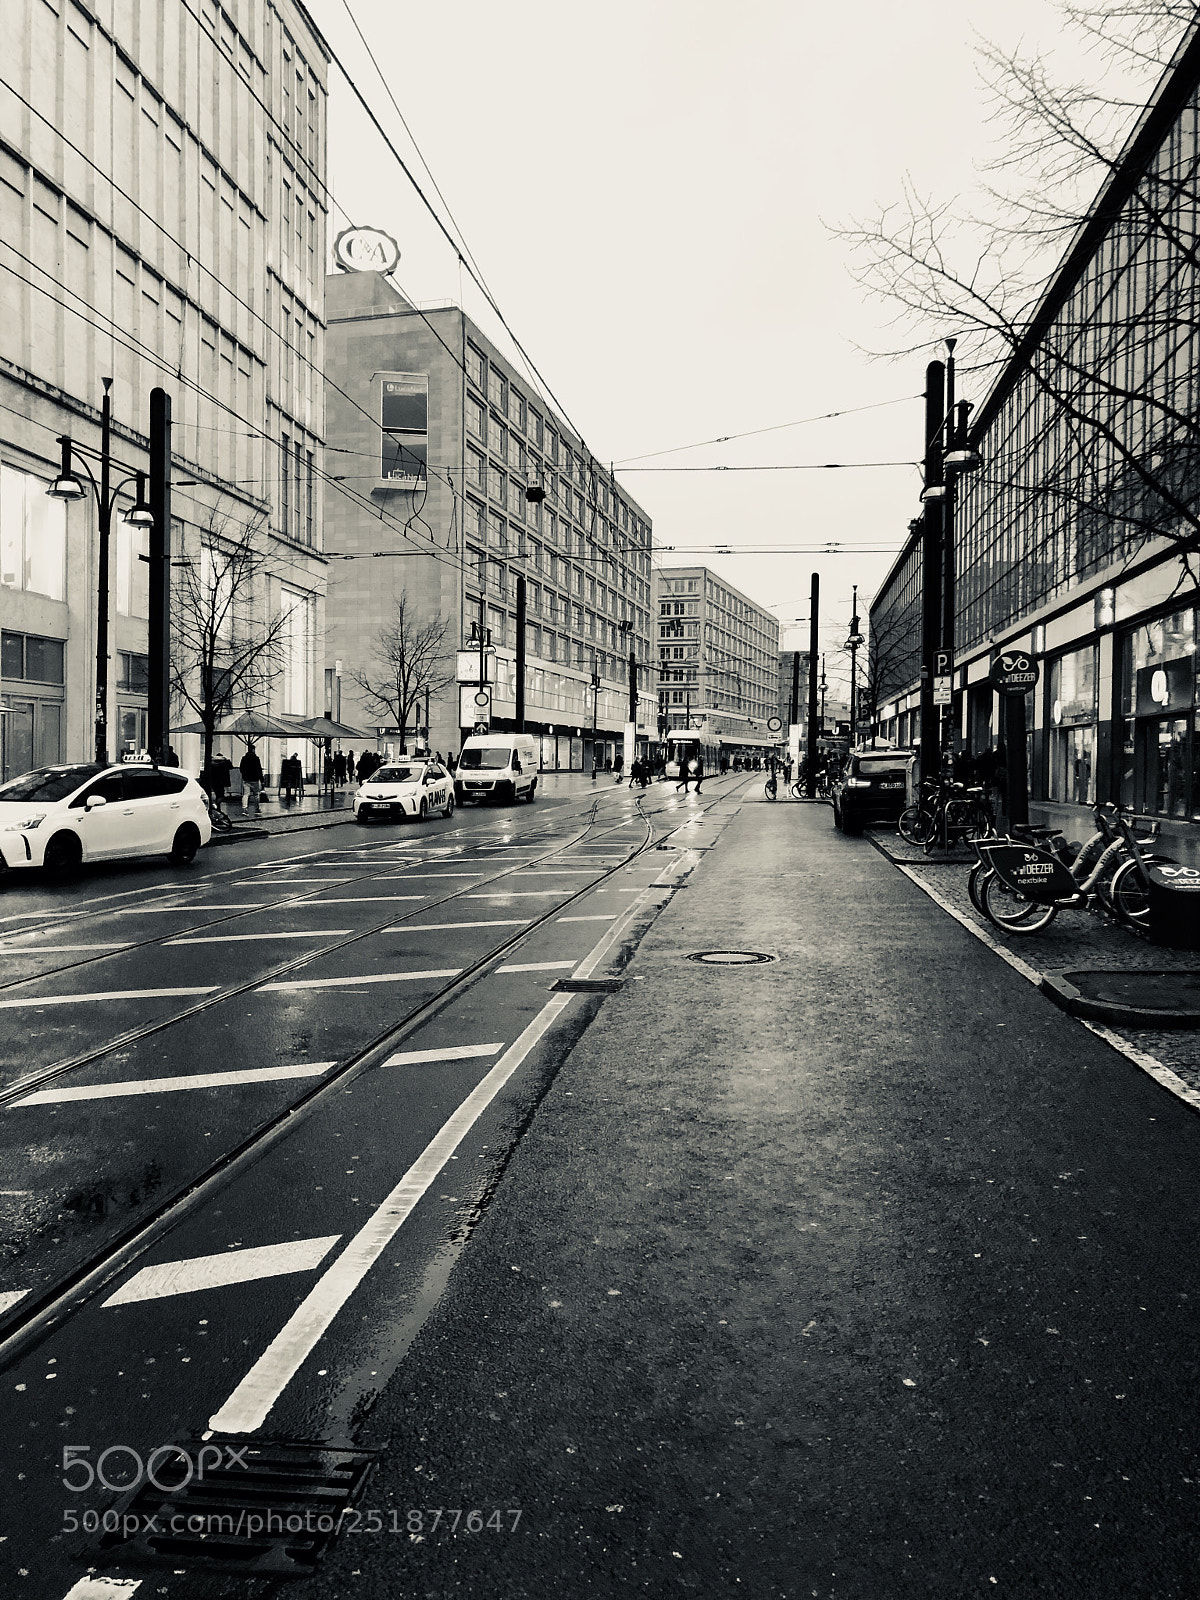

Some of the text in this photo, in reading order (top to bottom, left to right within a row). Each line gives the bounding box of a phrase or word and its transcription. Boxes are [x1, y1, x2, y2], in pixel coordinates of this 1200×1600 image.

[346, 238, 387, 263] C&A
[937, 654, 948, 674] P
[1011, 672, 1035, 683] DEEZER
[1151, 669, 1169, 706] Q
[1026, 863, 1054, 874] DEEZER
